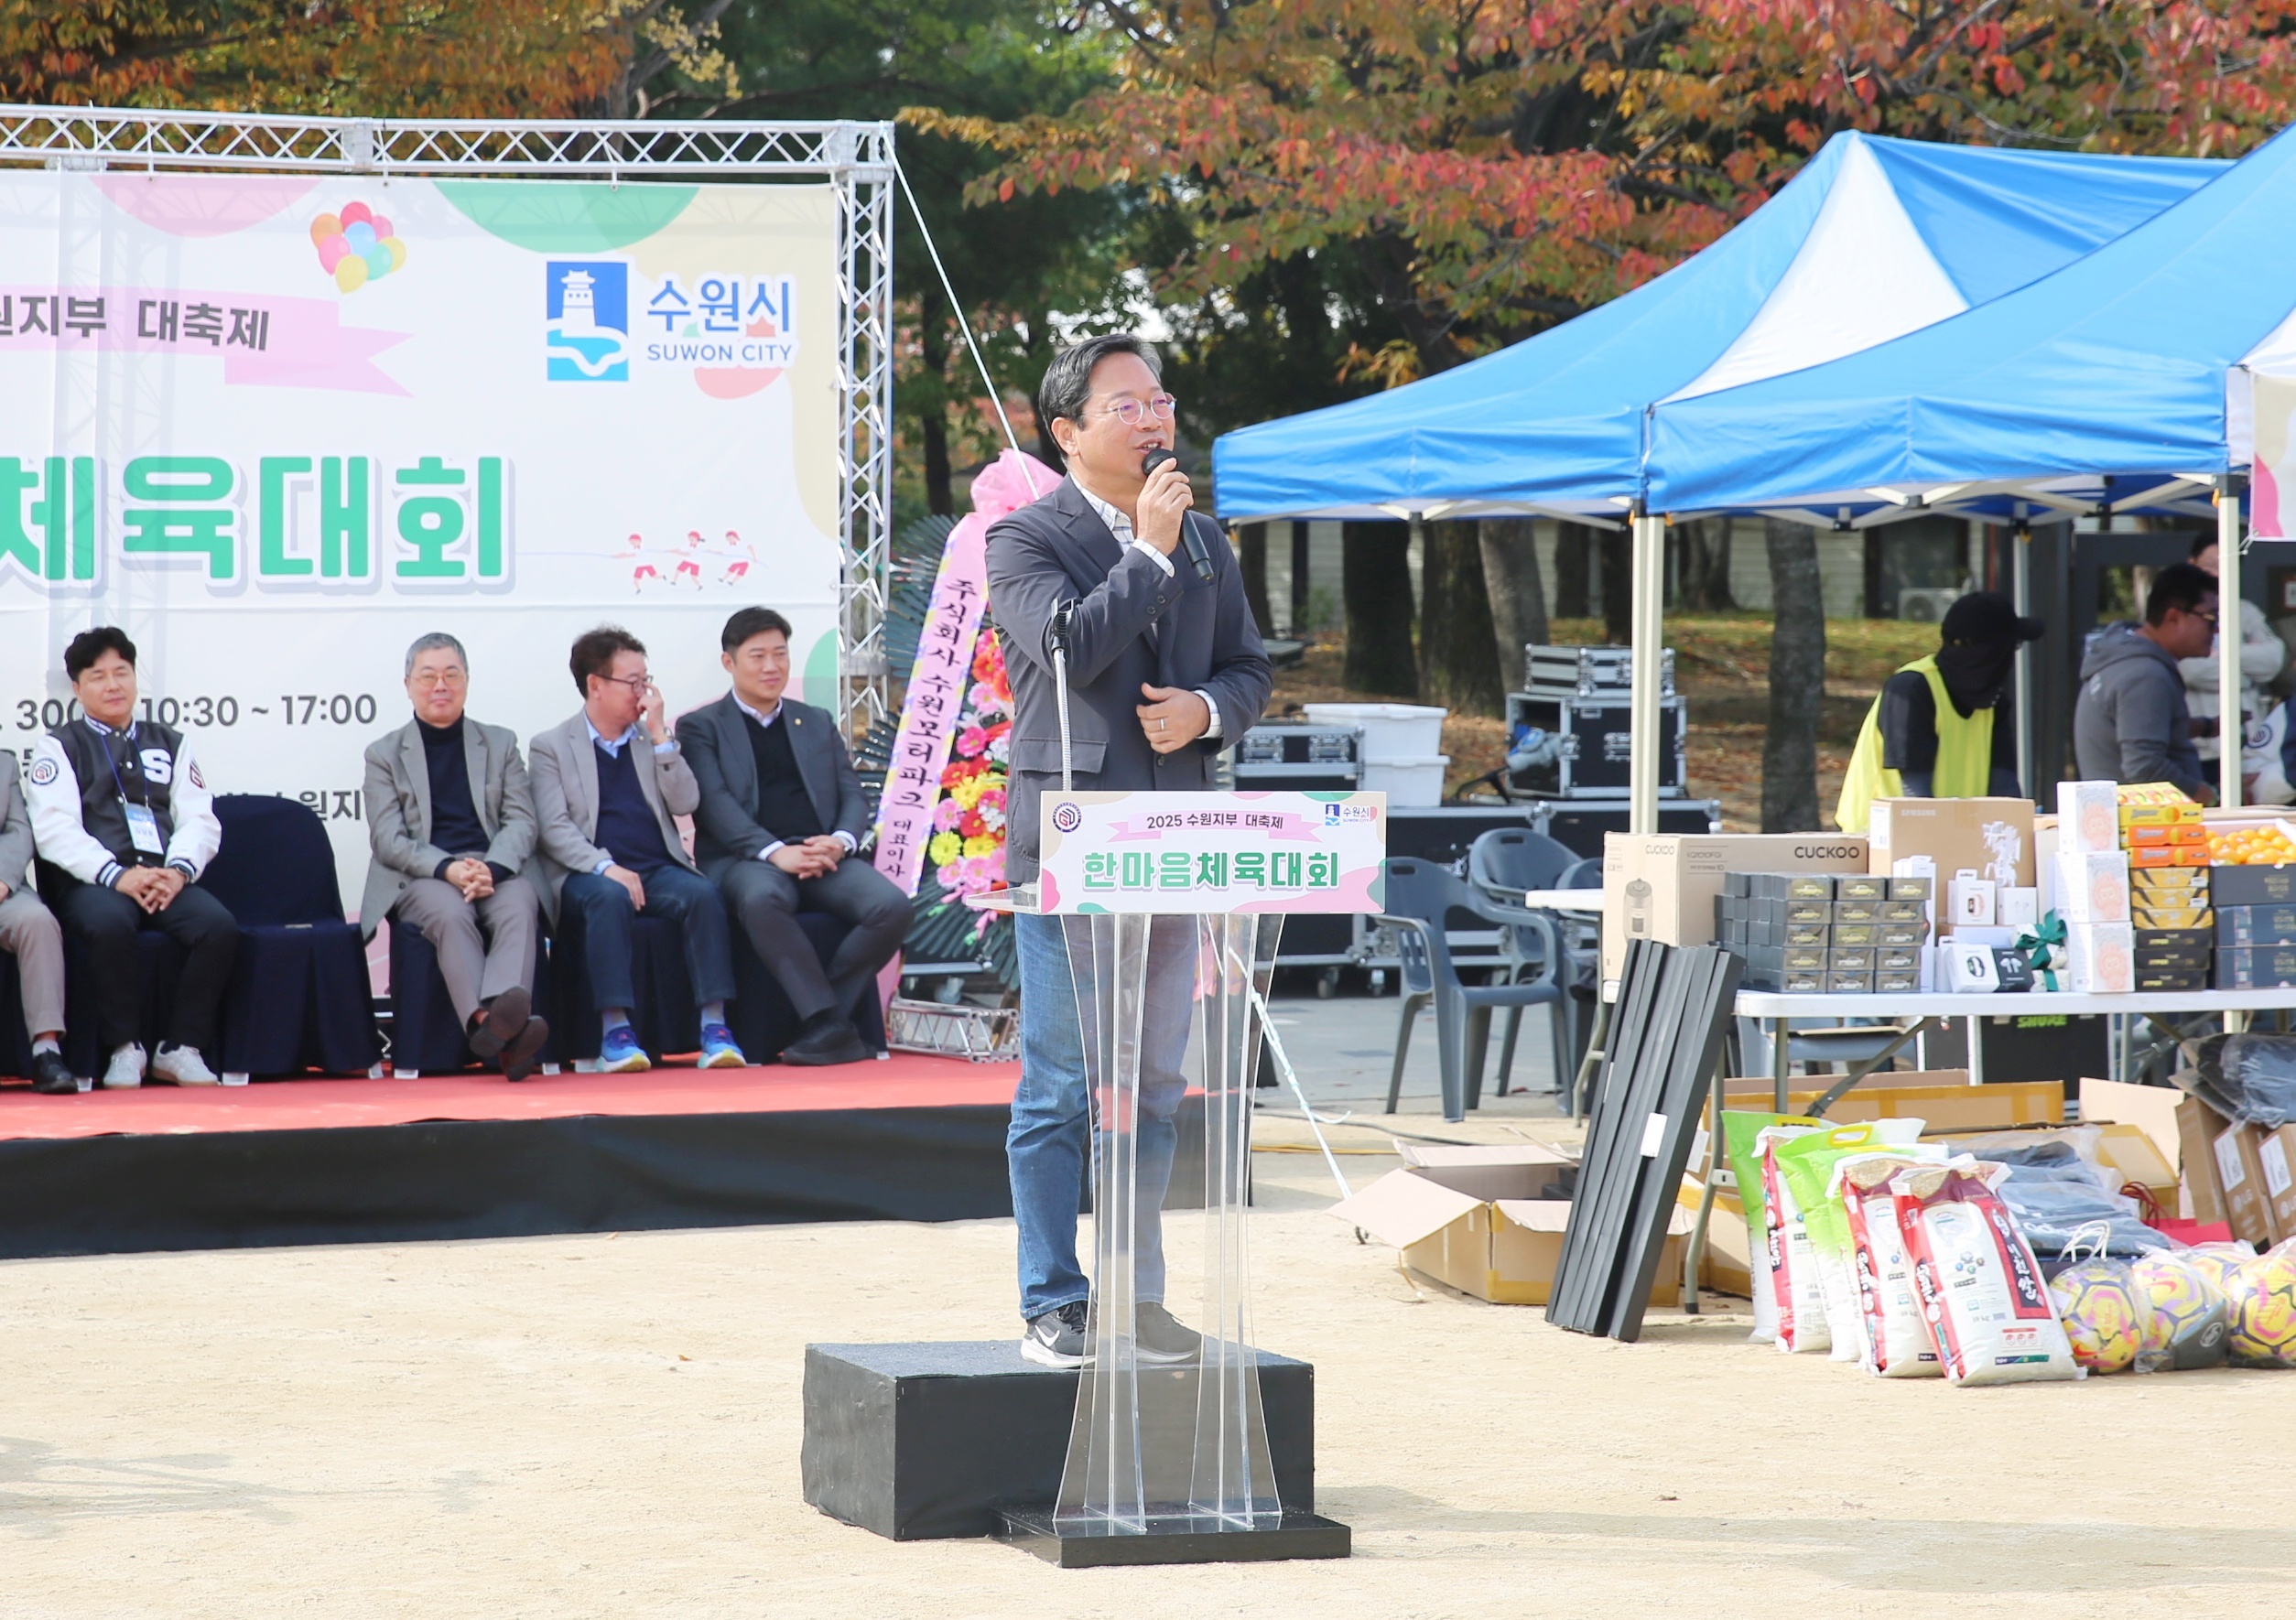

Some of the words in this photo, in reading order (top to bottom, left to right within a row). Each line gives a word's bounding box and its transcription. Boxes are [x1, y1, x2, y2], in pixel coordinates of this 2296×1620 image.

[647, 280, 789, 332] 수원시
[137, 299, 270, 351] 대축제
[647, 344, 733, 362] SUWON
[742, 343, 793, 362] CITY
[0, 456, 503, 581] 체육대회
[929, 578, 978, 668] 주식회사
[282, 695, 376, 726] 17:00
[141, 748, 172, 784] S
[1147, 815, 1183, 828] 2025
[1186, 813, 1238, 826] 수원지부
[1245, 814, 1283, 829] 대축제
[1343, 806, 1370, 817] 수원시
[883, 819, 913, 879] 대표이사
[1645, 845, 1674, 856] CUCKOO
[1794, 847, 1859, 859] CUCKOO
[1084, 852, 1338, 888] 한마음체육대회
[2017, 1015, 2067, 1028] SHURE
